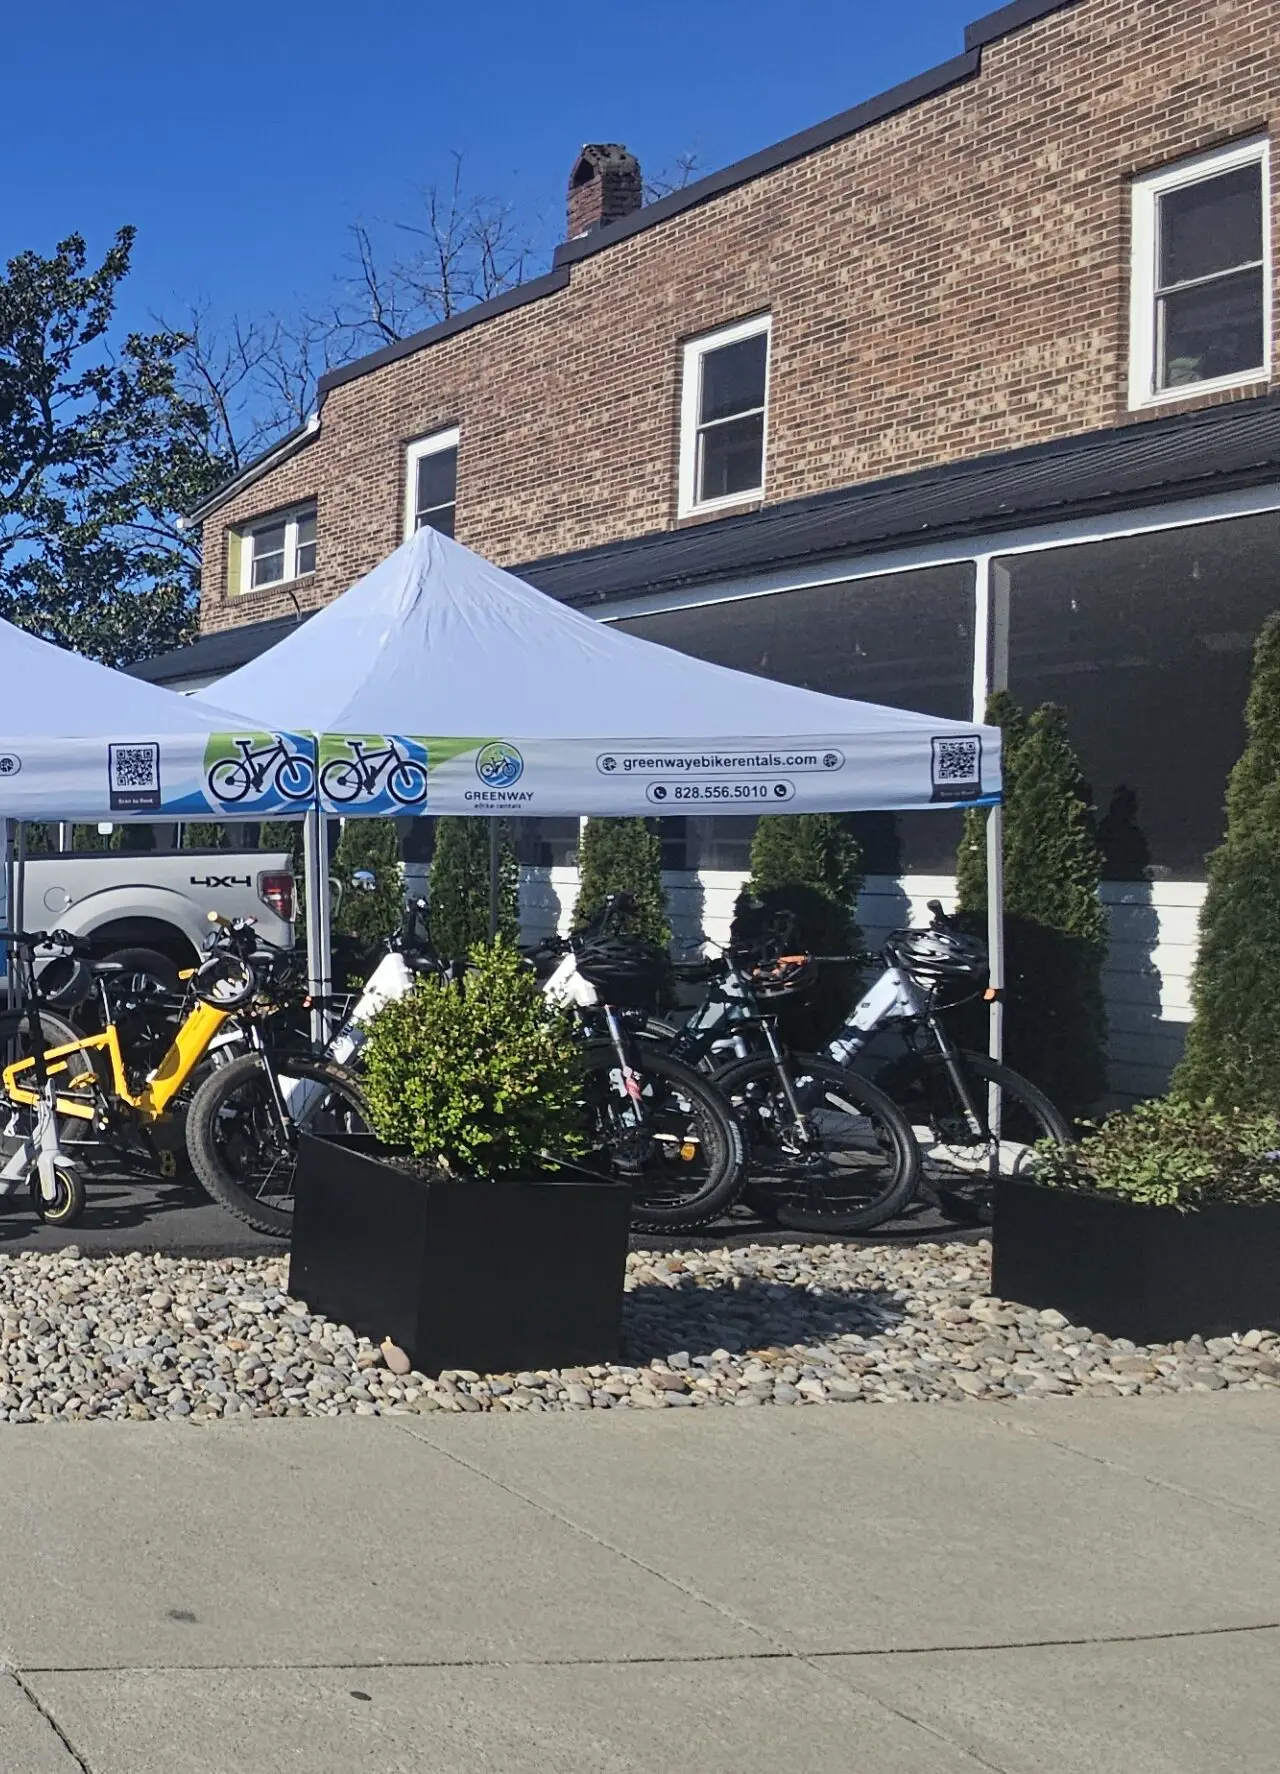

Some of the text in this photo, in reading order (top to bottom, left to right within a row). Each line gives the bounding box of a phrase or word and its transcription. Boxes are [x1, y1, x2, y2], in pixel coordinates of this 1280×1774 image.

[623, 753, 818, 771] greenwayebikerentals.com
[464, 791, 535, 801] GREENWAY
[674, 785, 768, 799] 828.556.5010
